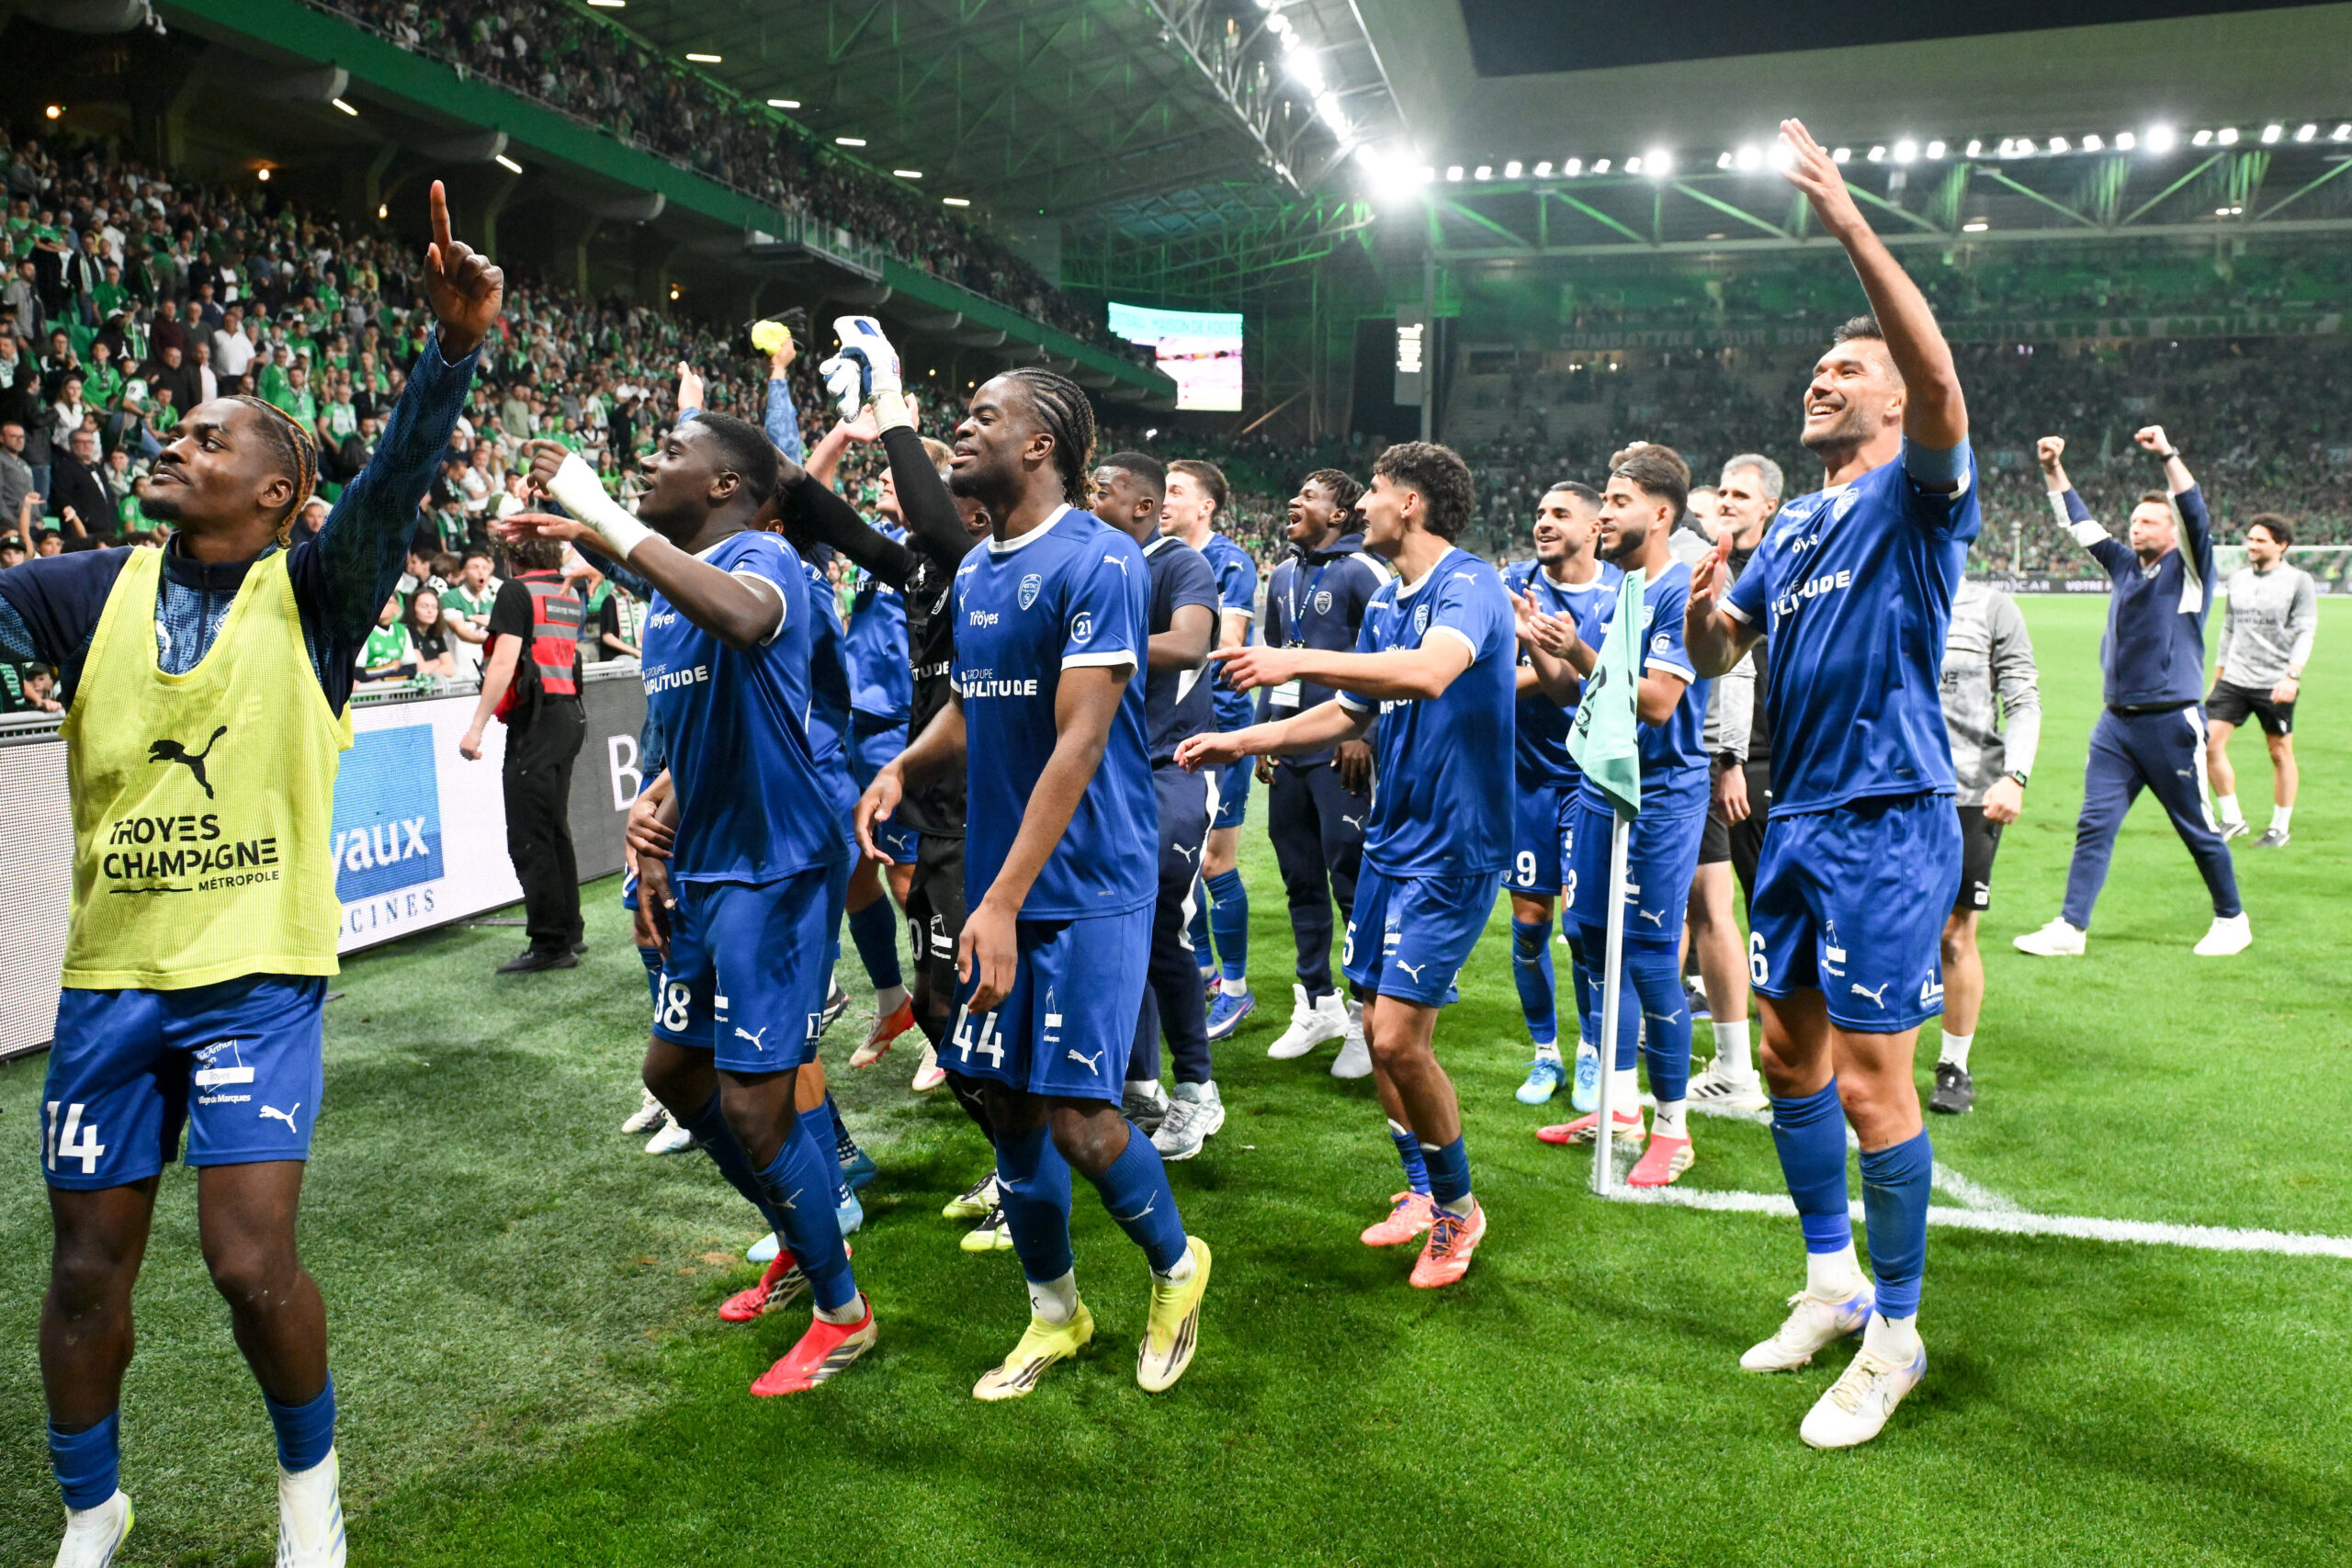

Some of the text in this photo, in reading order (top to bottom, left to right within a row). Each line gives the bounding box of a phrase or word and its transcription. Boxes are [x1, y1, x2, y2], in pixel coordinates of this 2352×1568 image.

[650, 613, 675, 629] Troyes
[969, 610, 999, 629] Troyes
[109, 814, 220, 845] TROYES
[103, 837, 279, 879] CHAMPAGNE
[1516, 851, 1537, 887] 9
[198, 870, 279, 892] MÉTROPOLE
[339, 888, 435, 938] CINES
[1748, 931, 1770, 987] 6
[951, 1003, 1005, 1069] 44
[218, 1094, 252, 1104] Marques
[46, 1100, 106, 1174] 14
